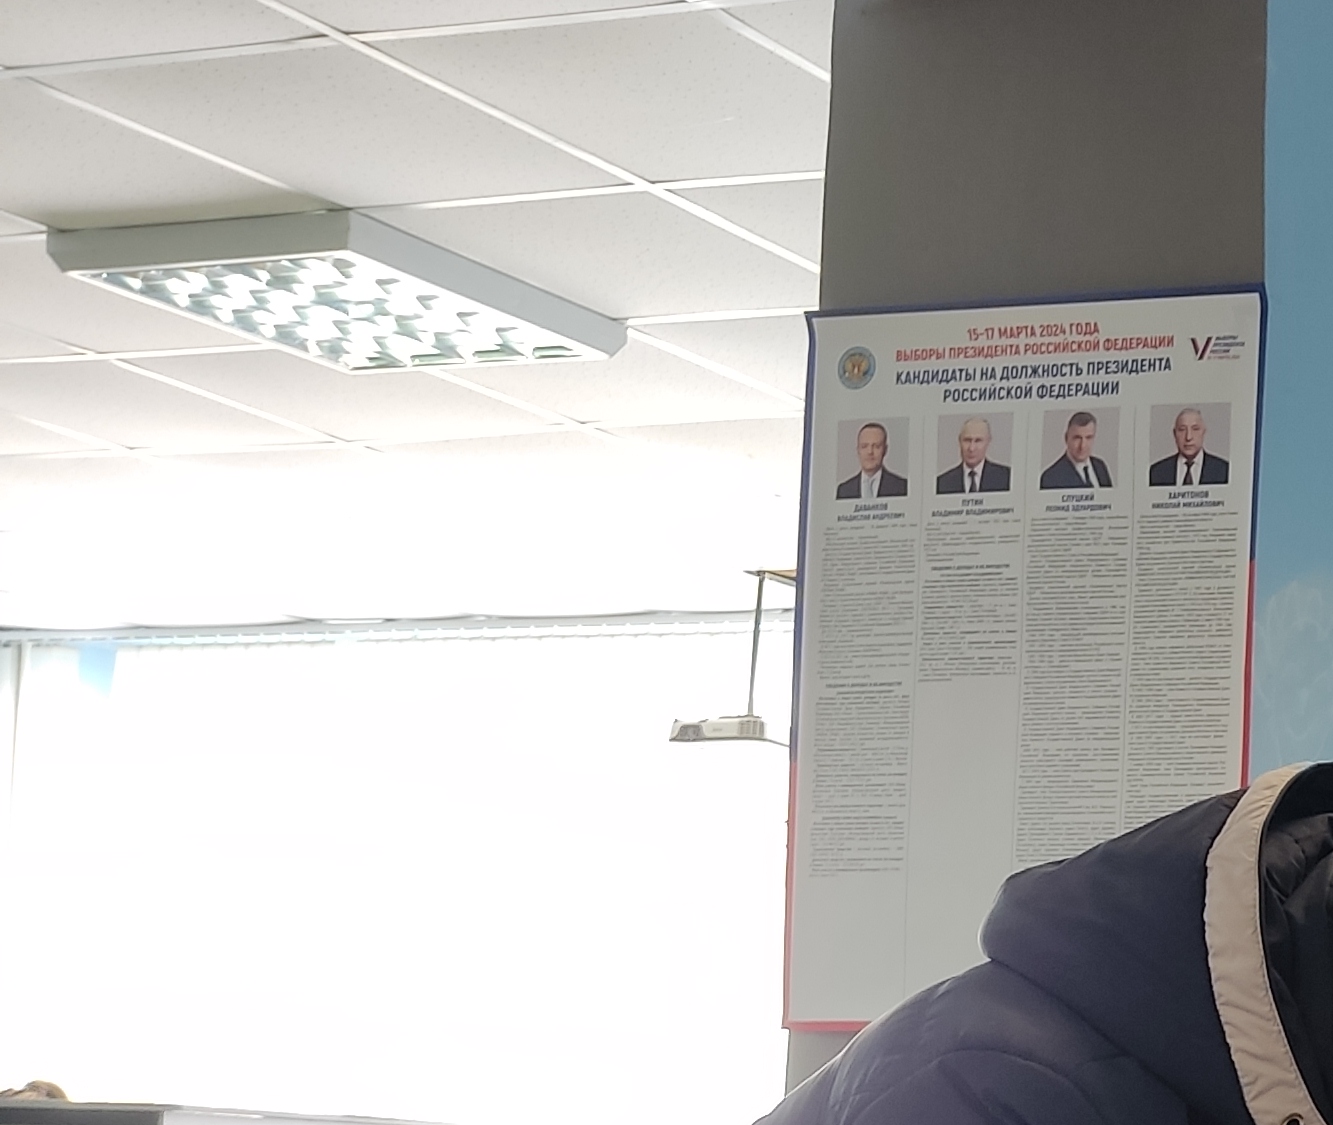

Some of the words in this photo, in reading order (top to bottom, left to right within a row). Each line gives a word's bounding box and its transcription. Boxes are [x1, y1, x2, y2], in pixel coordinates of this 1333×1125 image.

[967, 327, 995, 341] 15-17
[998, 325, 1037, 339] МАРТА
[1039, 323, 1066, 337] 2024
[1069, 322, 1100, 336] ГОДА
[896, 348, 946, 362] ВЫБОРЫ
[948, 344, 1020, 359] ПРЕЗИДЕНТА
[1023, 336, 1100, 355] РОССИЙСКОЙ
[1102, 335, 1174, 351] ФЕДЕРАЦИИ
[895, 367, 976, 385] КАНДИДАТЫ
[979, 366, 997, 381] НА
[999, 361, 1083, 381] ДОЛЖНОСТЬ
[1086, 357, 1172, 376] ПРЕЗИДЕНТА
[943, 382, 1033, 403] РОССИЙСКОЙ
[1036, 380, 1120, 400] ФЕДЕРАЦИИ
[961, 498, 984, 507] ПУТИН
